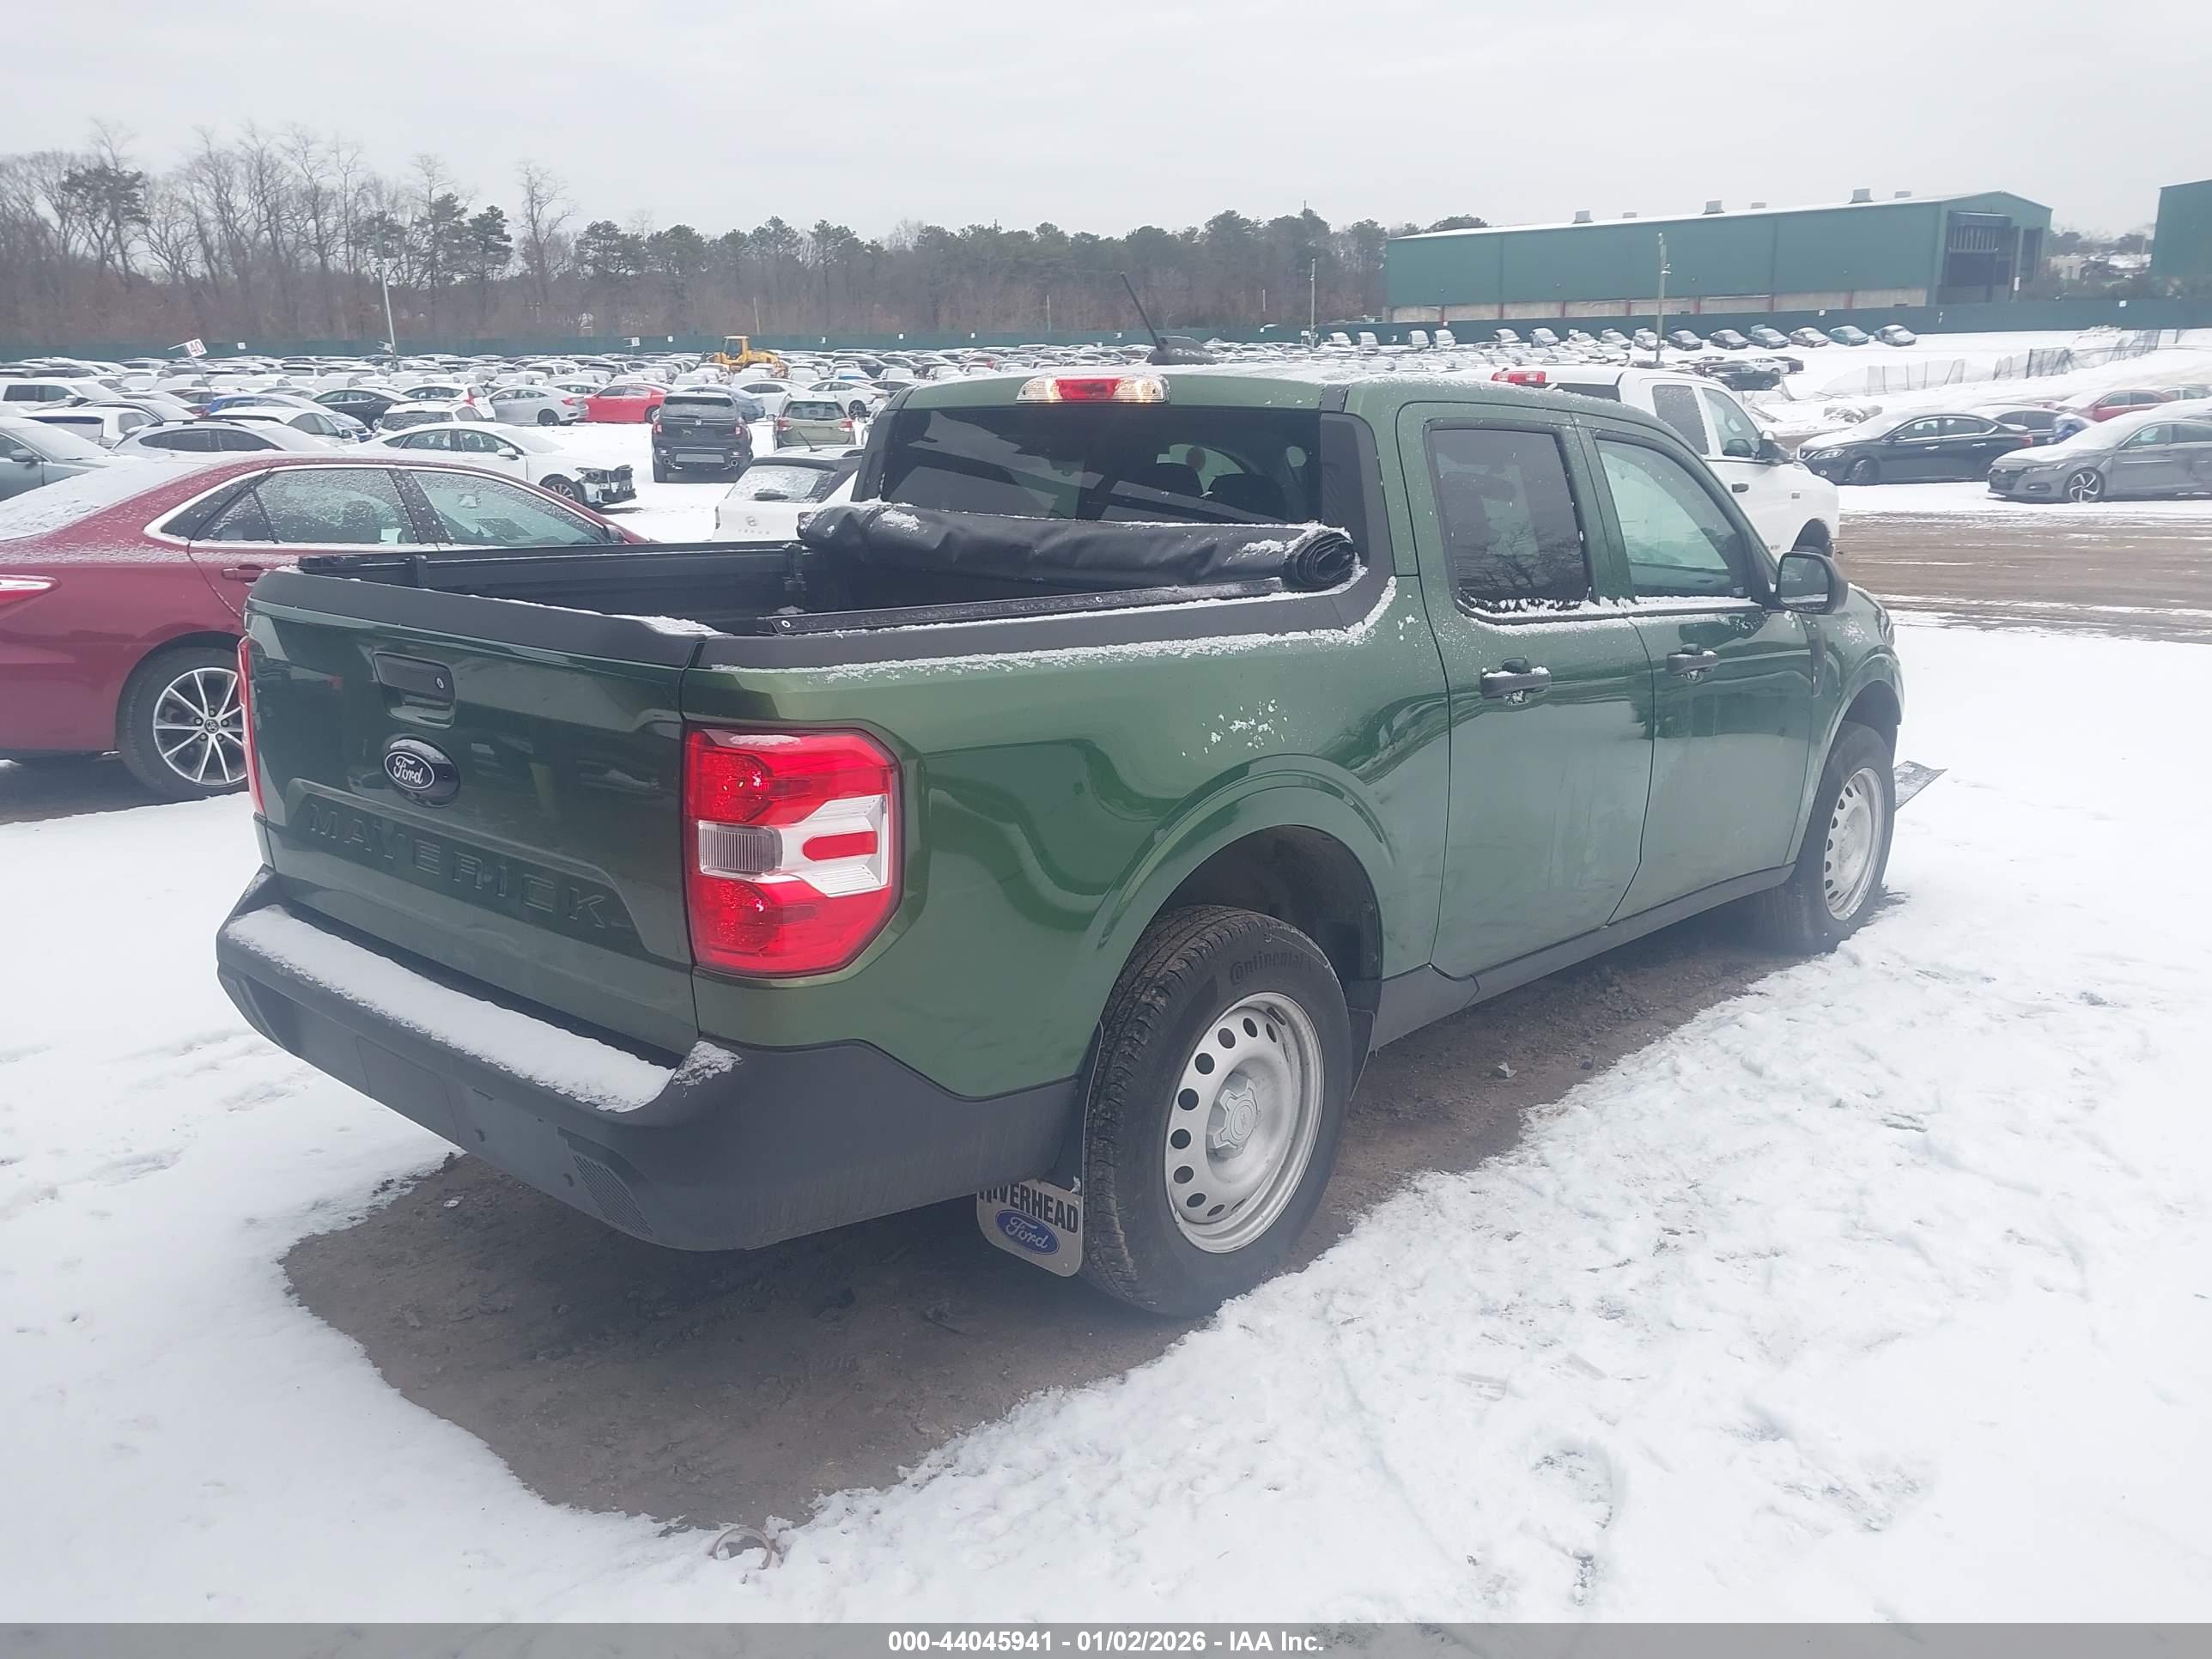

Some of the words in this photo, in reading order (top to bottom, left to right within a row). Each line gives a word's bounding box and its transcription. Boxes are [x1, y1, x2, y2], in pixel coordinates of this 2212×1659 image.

[393, 756, 423, 785] Ford
[309, 804, 605, 929] MAVERICK
[1006, 1216, 1049, 1249] Ford
